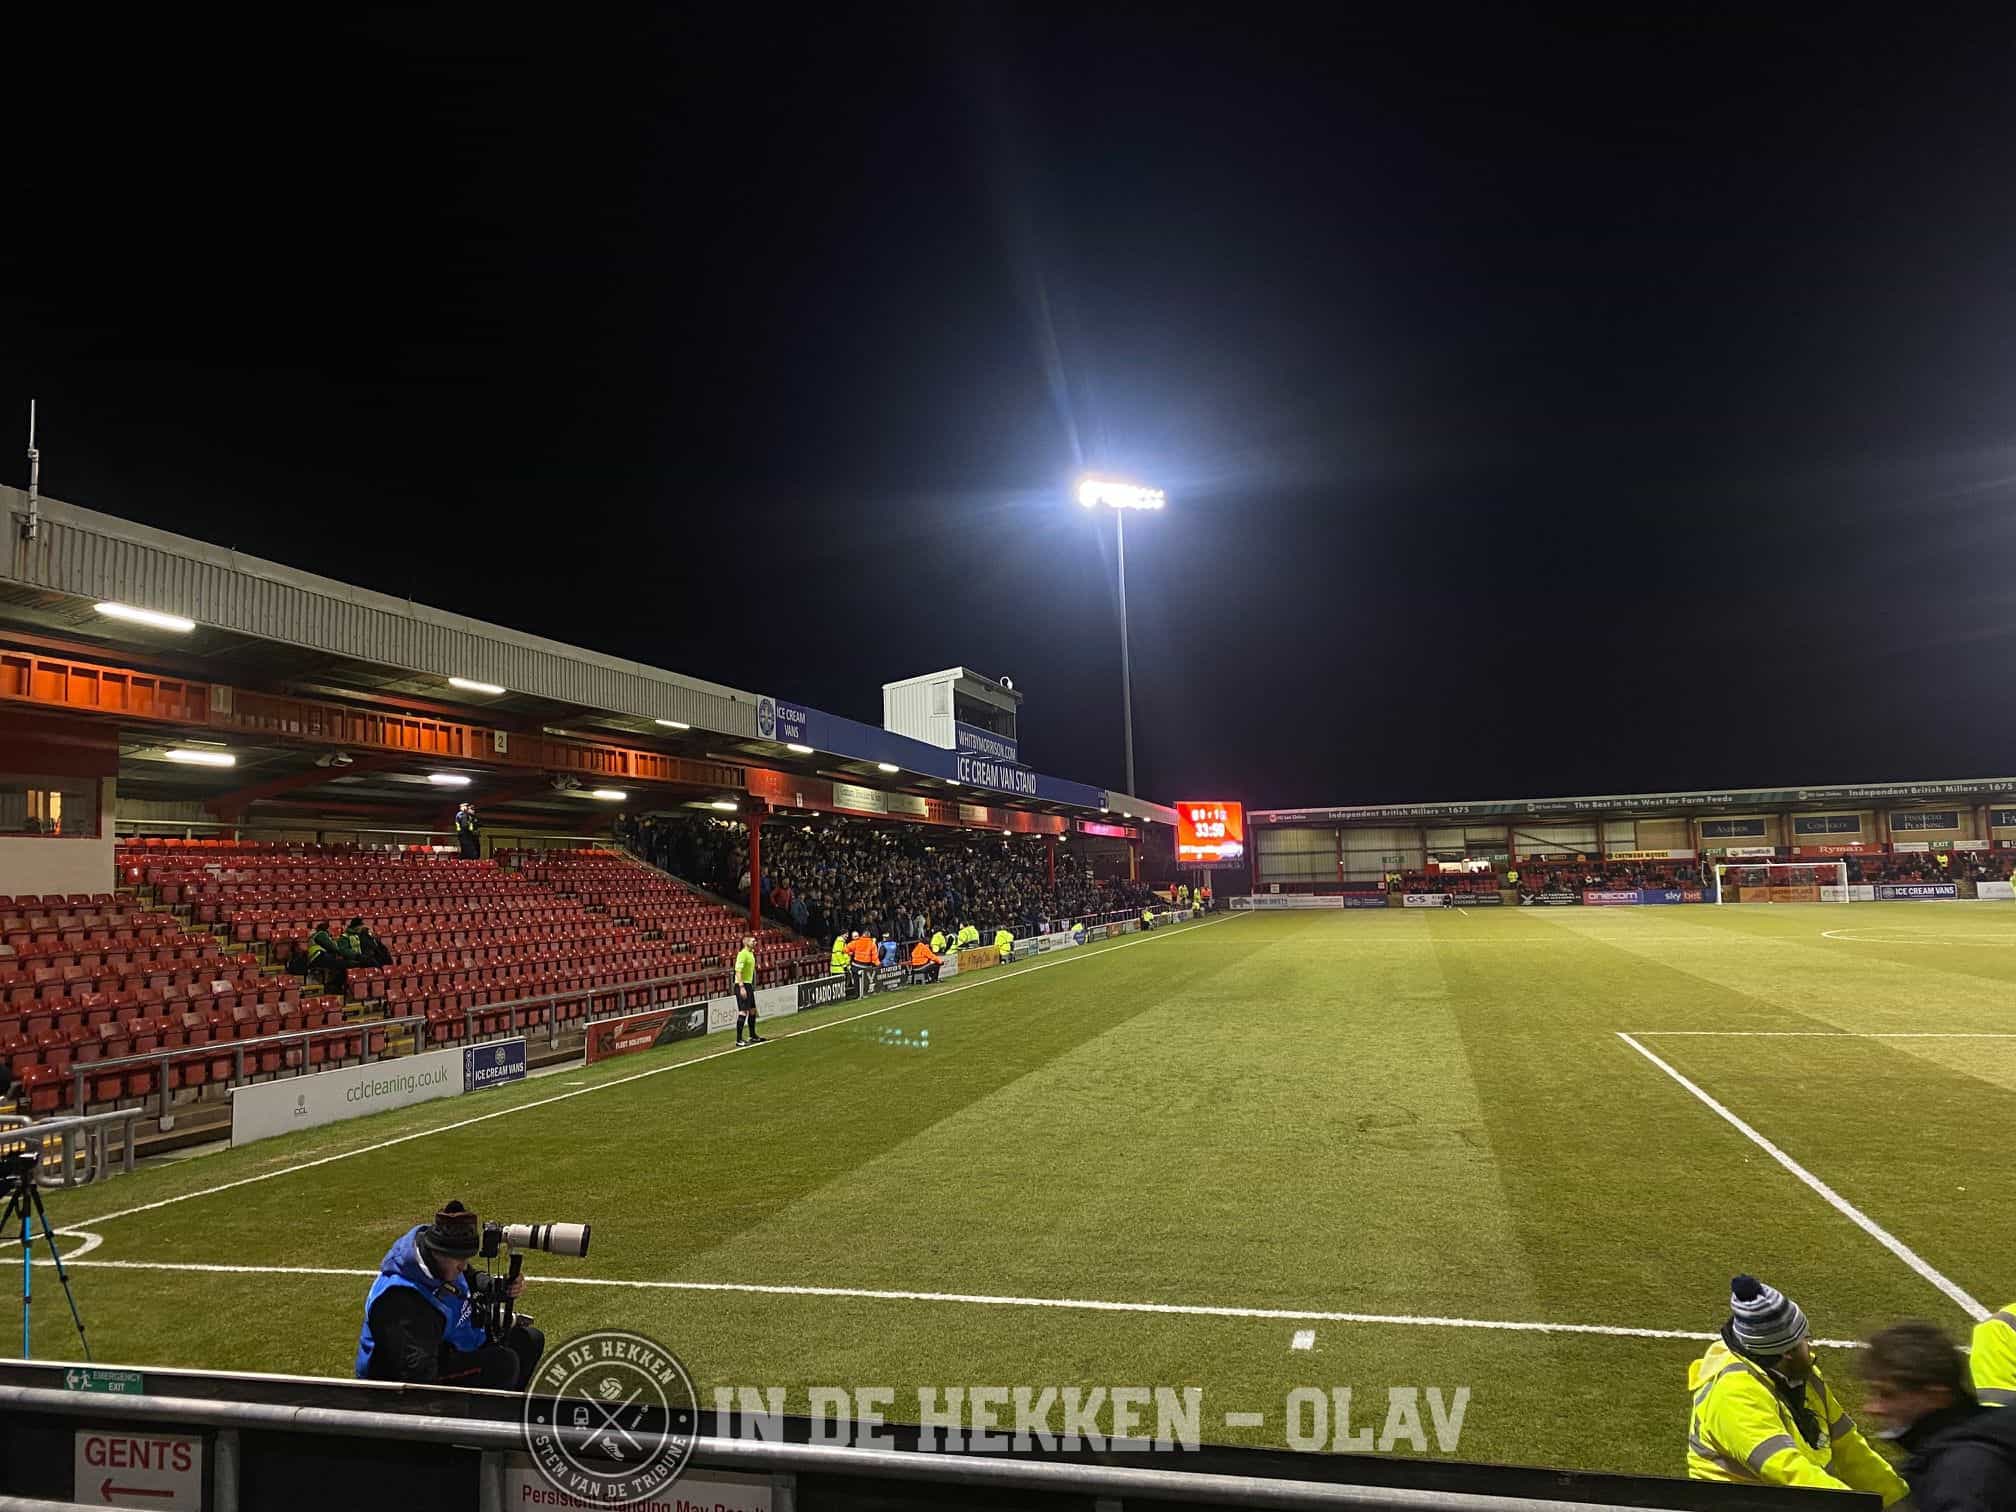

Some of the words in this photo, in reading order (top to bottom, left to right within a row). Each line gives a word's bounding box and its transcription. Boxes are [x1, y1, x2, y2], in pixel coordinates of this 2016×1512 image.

[776, 705, 786, 720] ICE
[786, 709, 806, 724] CREAM
[784, 724, 799, 738] VANS
[498, 736, 504, 748] 2
[958, 730, 1016, 760] WHITBYMORRISON.COM
[957, 756, 970, 781] ICE
[971, 761, 998, 787] CREAM
[999, 766, 1015, 790] VAN
[1015, 771, 1037, 794] STAND
[1849, 789, 1908, 798] Independent
[1911, 786, 1943, 794] British
[1945, 785, 1978, 793] Millers
[1624, 799, 1638, 807] the
[1328, 810, 1380, 819] Independent
[1381, 807, 1409, 816] British
[1410, 807, 1439, 816] Millers
[1664, 890, 1681, 902] sky
[1895, 887, 1908, 896] ICE
[1908, 887, 1935, 896] CREAM
[1935, 886, 1955, 895] VANS
[475, 1069, 486, 1080] ICE
[486, 1066, 508, 1079] CREAM
[509, 1062, 524, 1074] VANS
[346, 1064, 449, 1102] cclcleaning.co.uk
[93, 1371, 142, 1382] EMERGENCY
[108, 1382, 125, 1392] EXIT
[84, 1437, 192, 1472] GENTS
